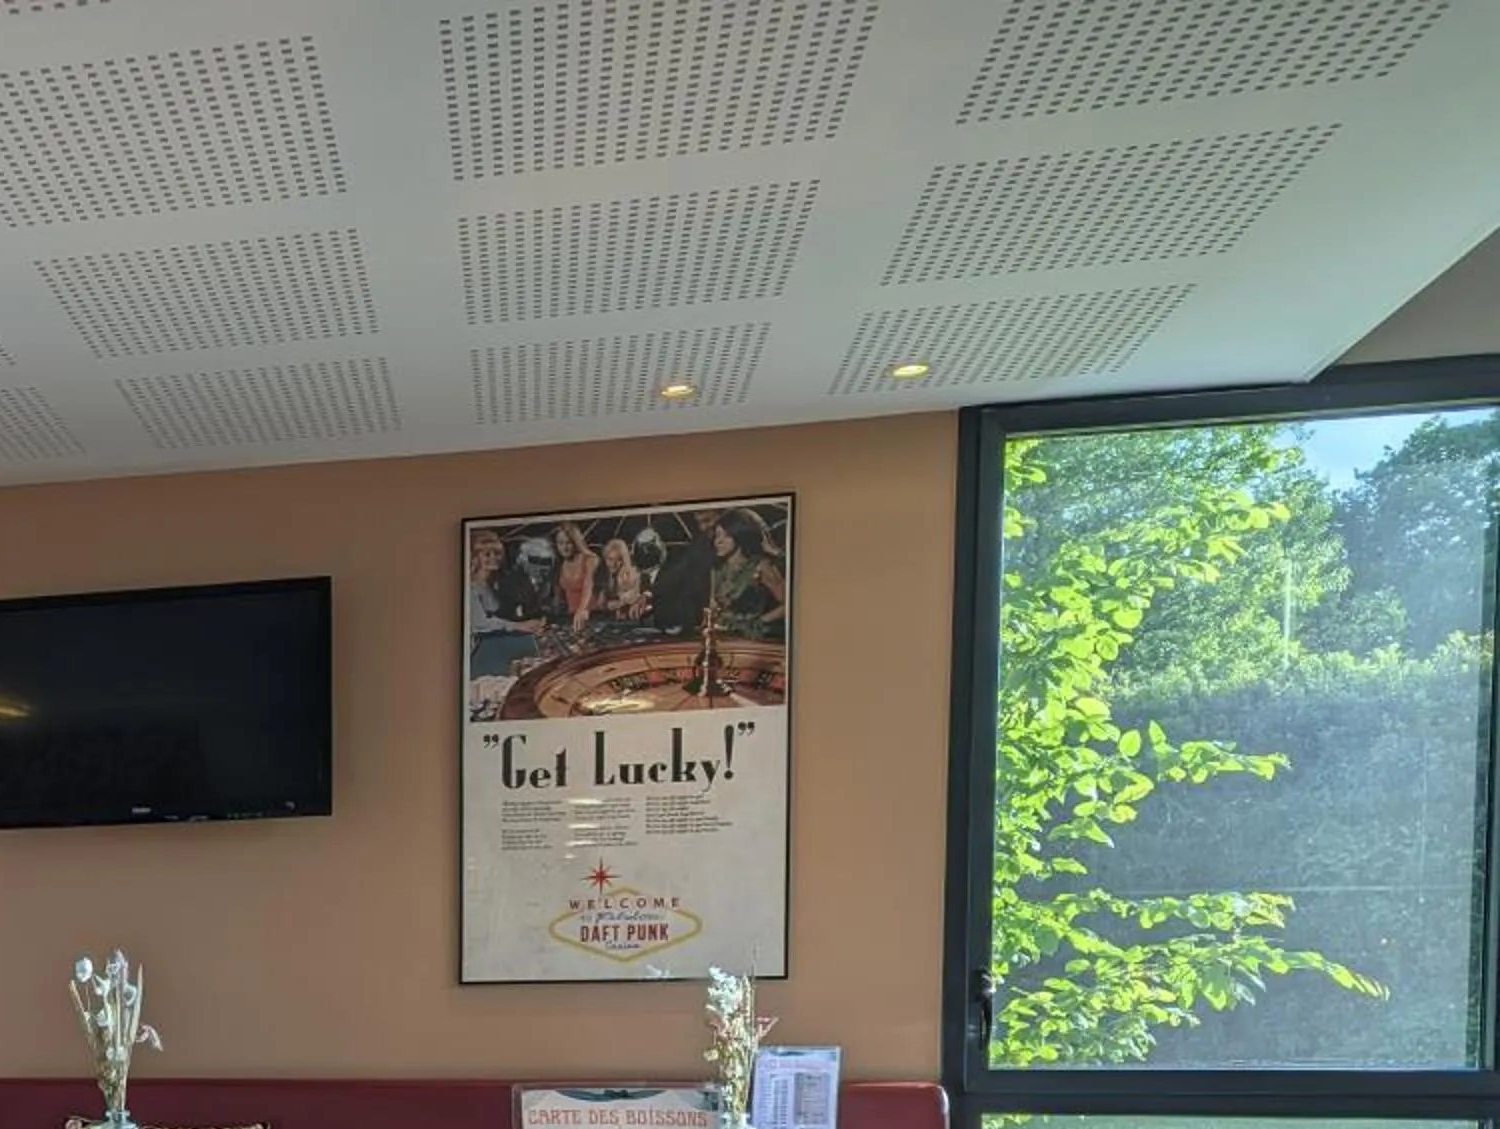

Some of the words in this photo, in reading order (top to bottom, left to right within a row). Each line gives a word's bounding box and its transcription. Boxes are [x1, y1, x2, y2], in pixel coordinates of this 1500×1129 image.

[568, 897, 680, 910] WELCOME
[580, 924, 620, 942] DAFT
[627, 923, 669, 941] PUNK
[528, 1109, 582, 1125] CARTE
[588, 1109, 619, 1125] DES
[625, 1105, 707, 1127] BOISSONS
